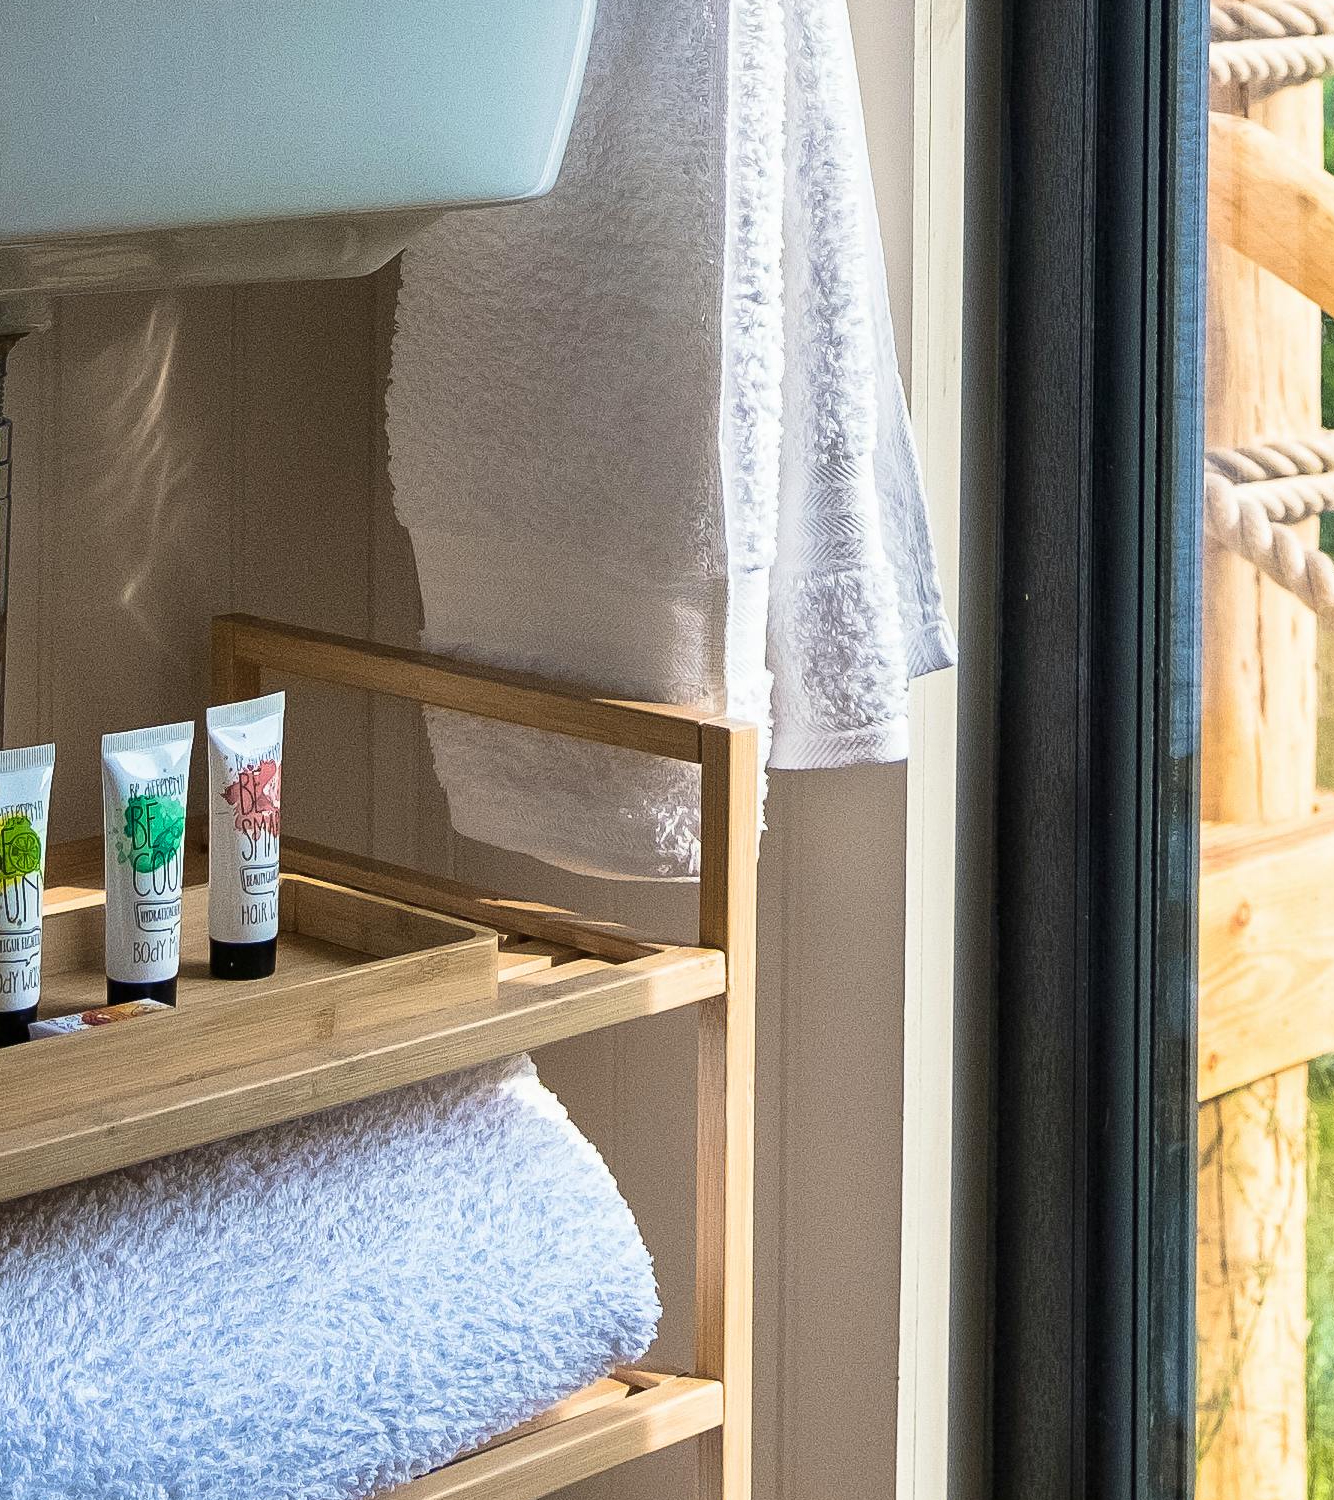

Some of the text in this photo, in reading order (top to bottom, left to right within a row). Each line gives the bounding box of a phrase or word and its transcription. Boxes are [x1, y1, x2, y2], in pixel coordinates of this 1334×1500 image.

[238, 769, 267, 817] BE
[131, 802, 159, 851] BE
[241, 809, 279, 862] SMAR
